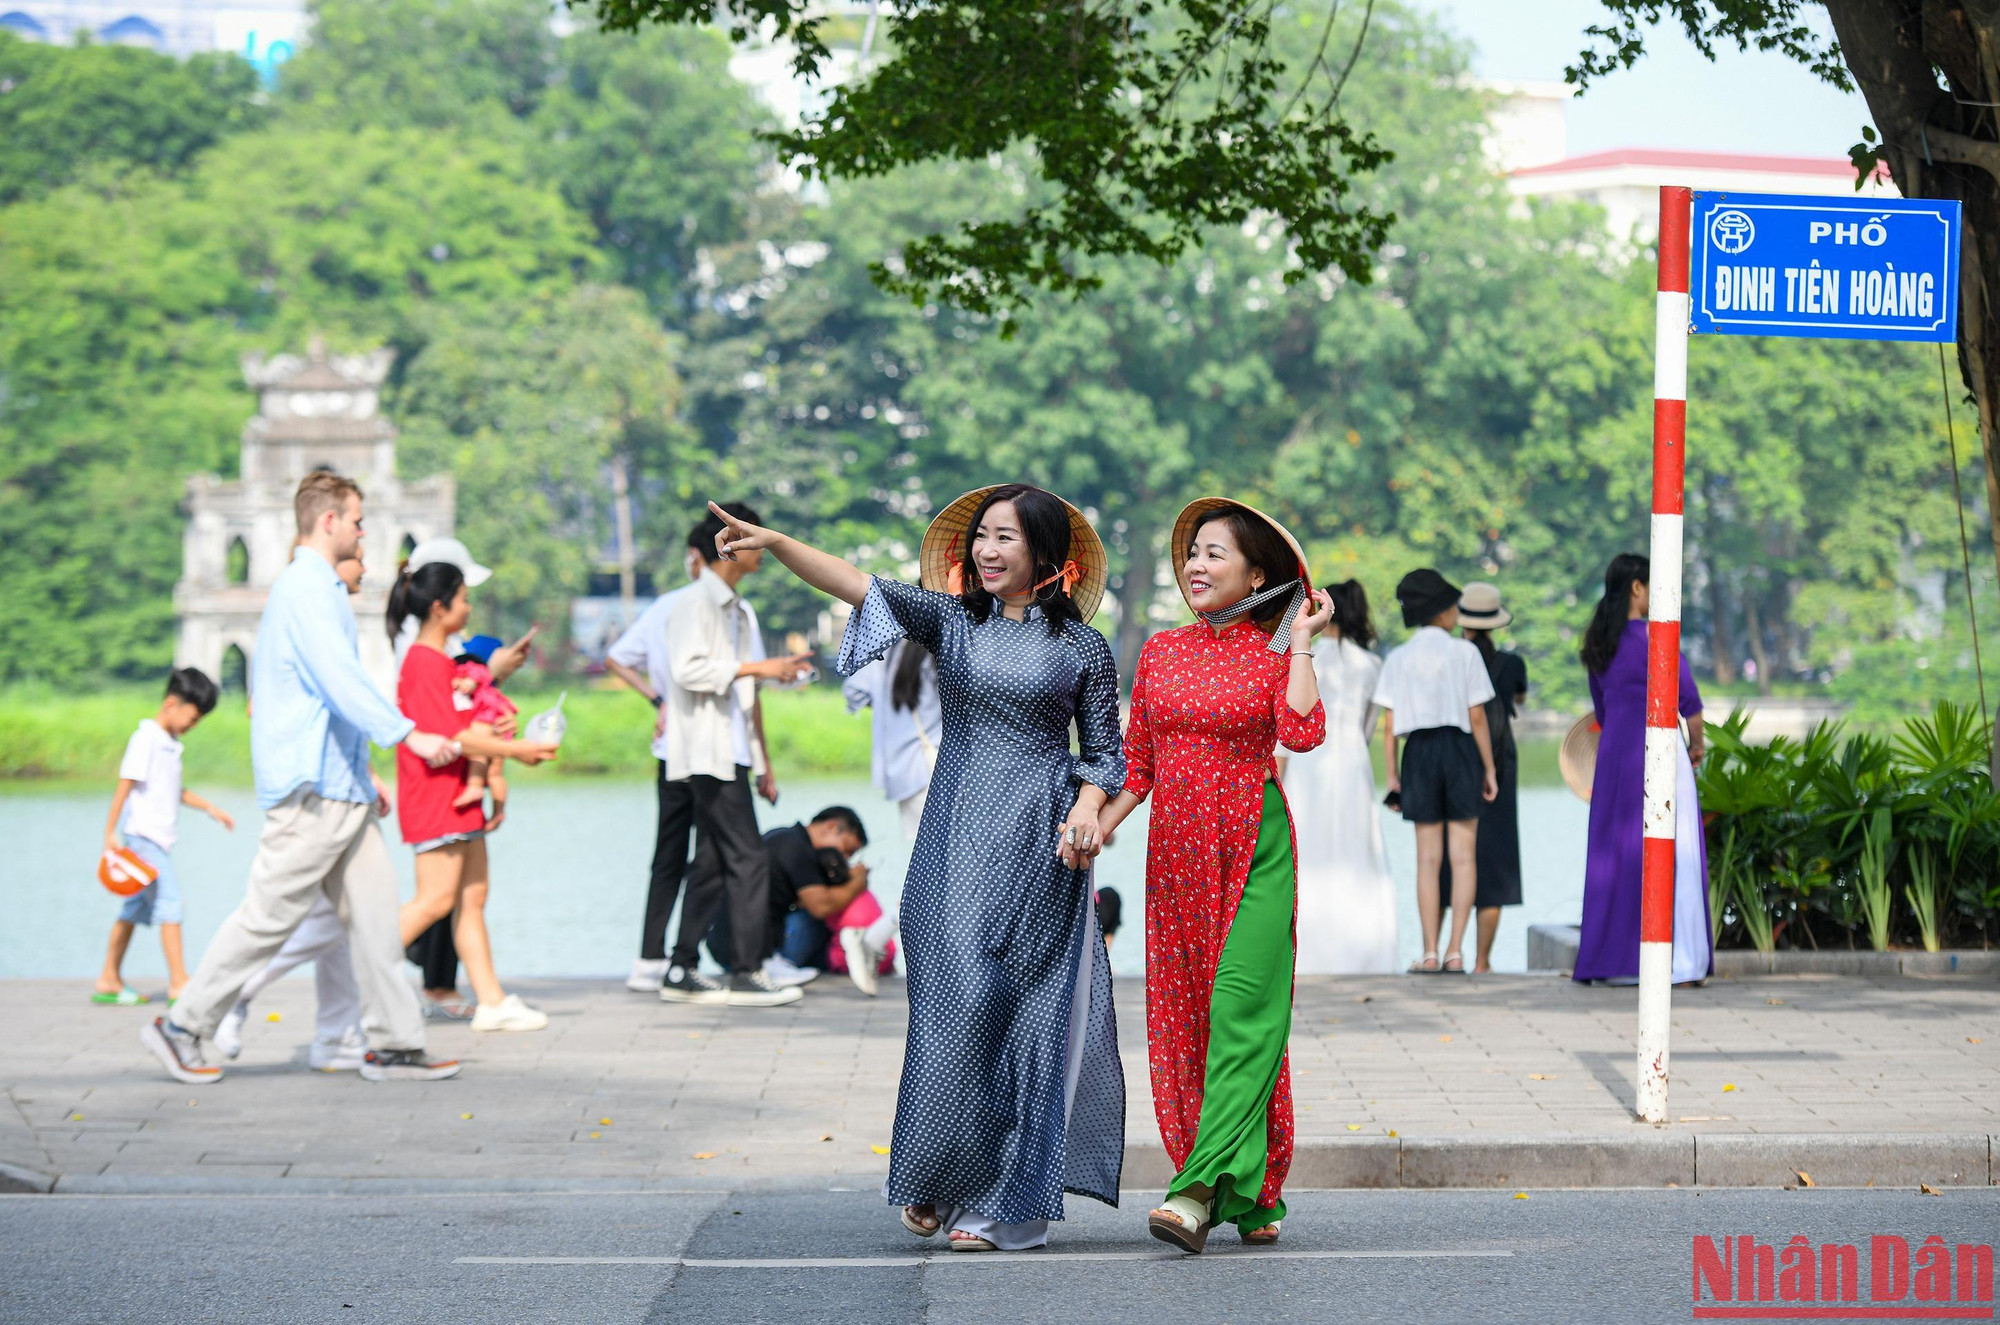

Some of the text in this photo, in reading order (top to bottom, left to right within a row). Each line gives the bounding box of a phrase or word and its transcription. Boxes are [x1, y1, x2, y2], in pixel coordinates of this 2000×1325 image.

[1810, 214, 1892, 247] PHỐ
[1715, 258, 1934, 318] ĐINH TIÊN HOÀNG
